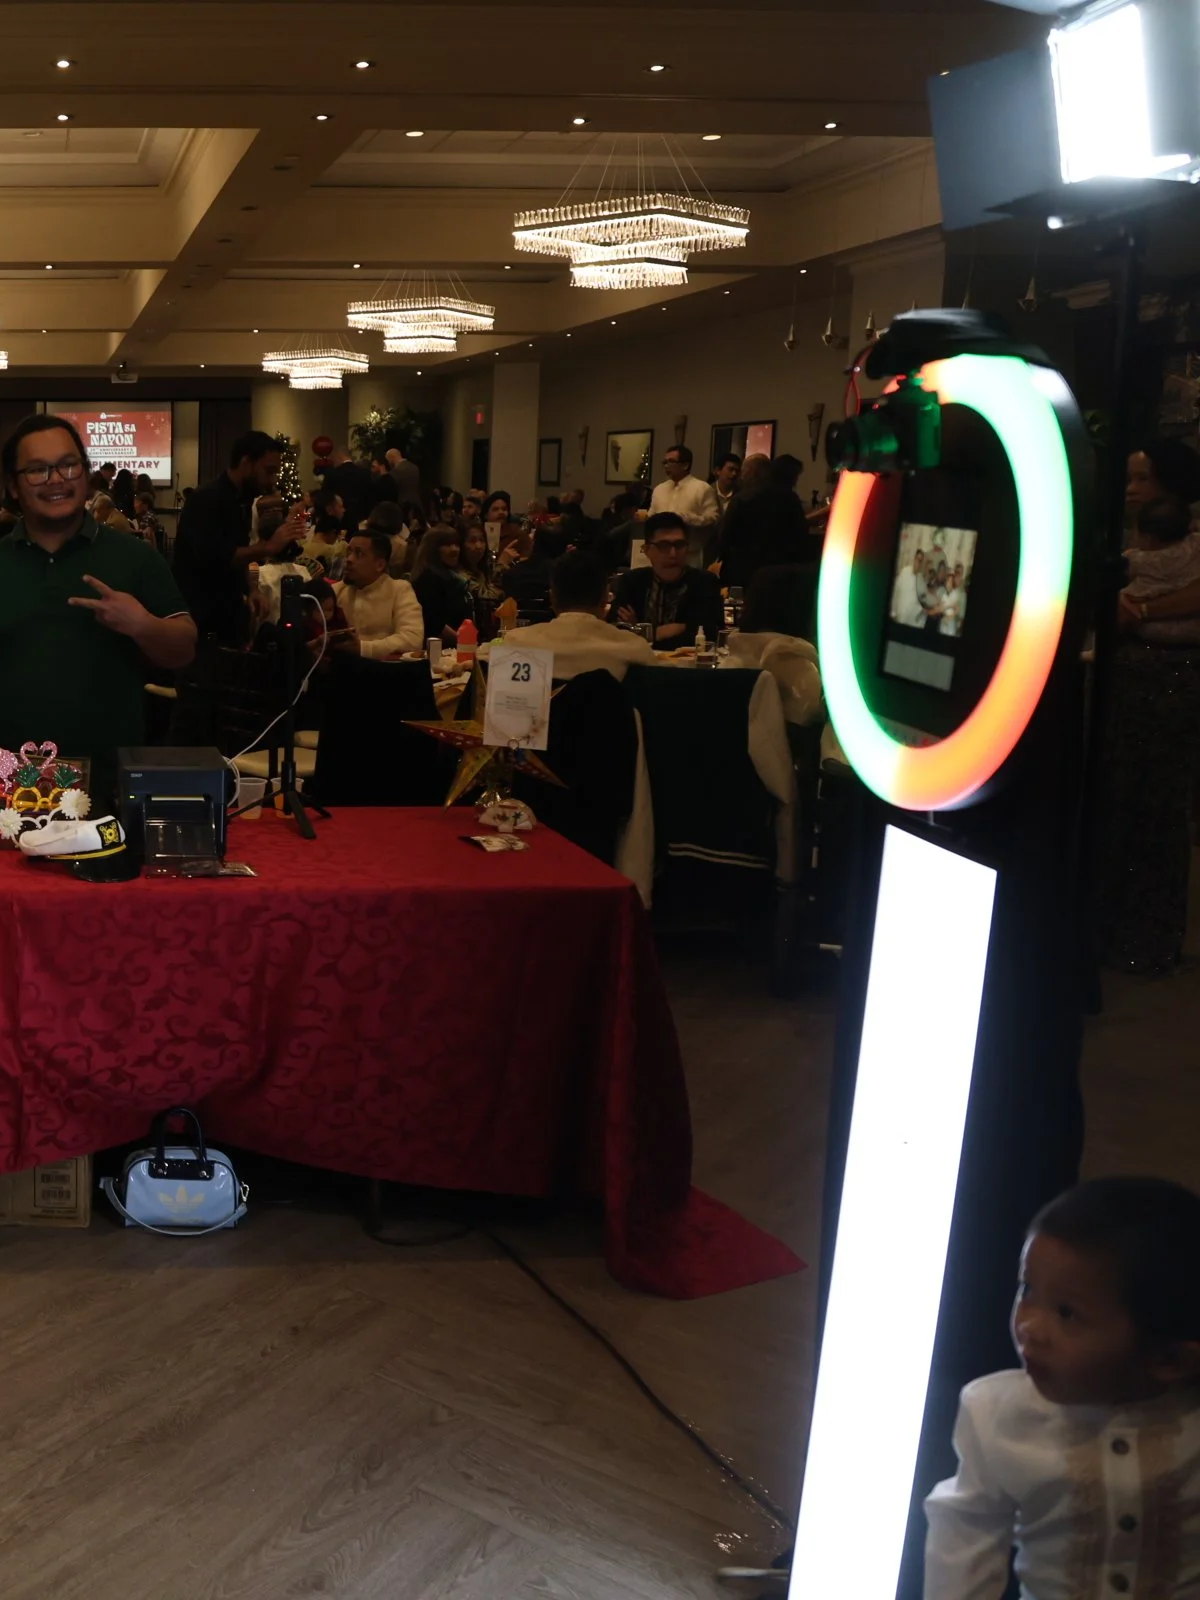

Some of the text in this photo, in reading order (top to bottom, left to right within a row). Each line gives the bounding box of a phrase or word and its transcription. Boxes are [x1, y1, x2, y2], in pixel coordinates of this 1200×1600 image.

[86, 422, 136, 434] PISTA SA
[90, 434, 133, 446] NAYON
[511, 662, 531, 682] 23
